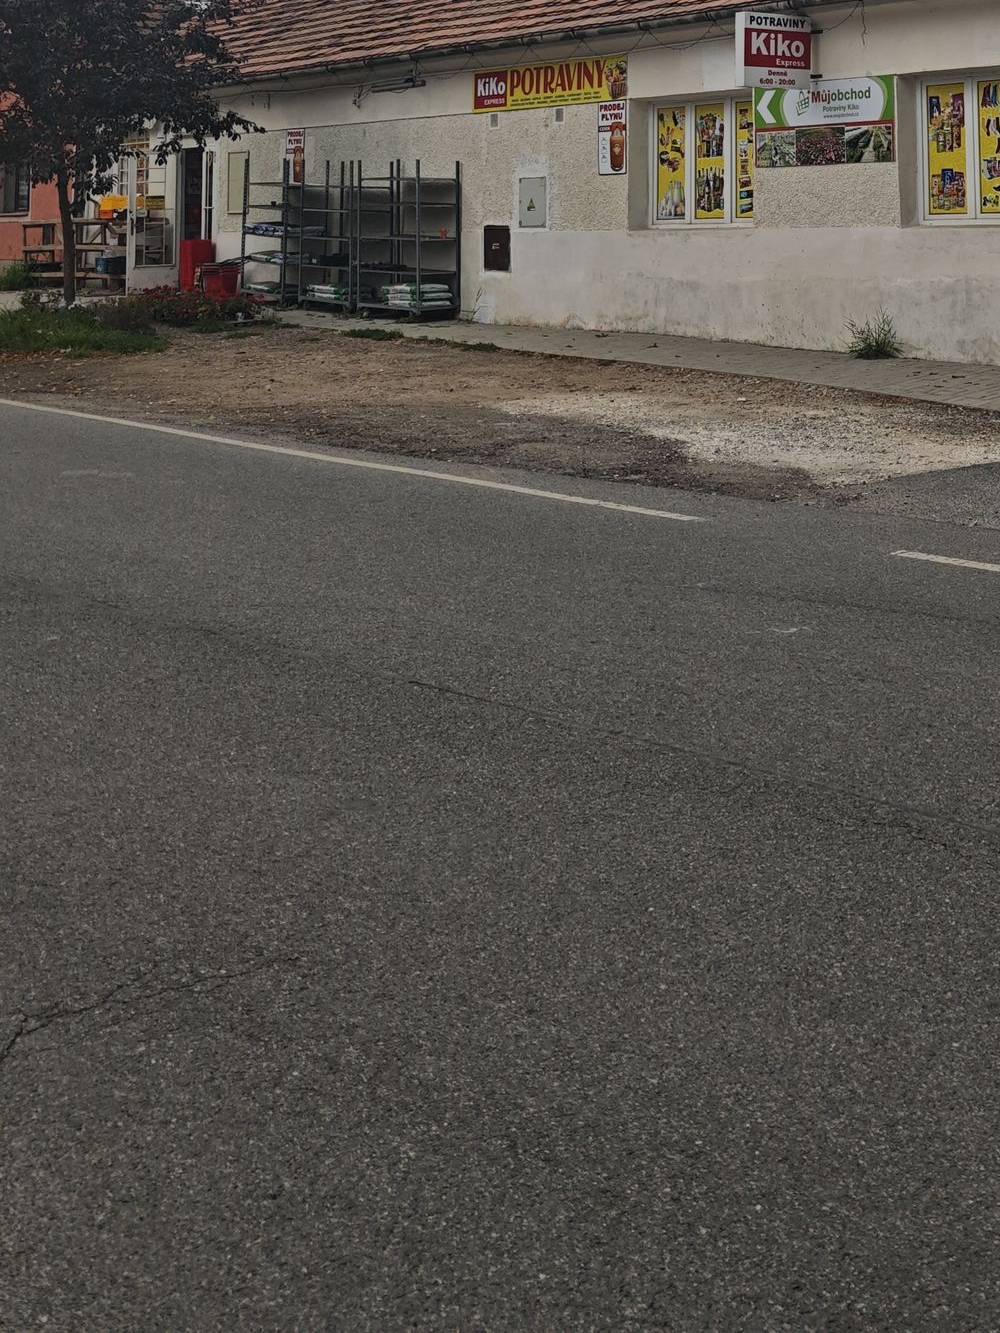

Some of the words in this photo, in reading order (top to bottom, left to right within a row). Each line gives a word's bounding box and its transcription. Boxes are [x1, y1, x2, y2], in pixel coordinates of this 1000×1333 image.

[750, 15, 806, 28] POTRAVINY
[751, 31, 805, 58] Kiko
[776, 58, 805, 67] Express
[510, 59, 606, 96] POTRAVINY
[811, 86, 871, 104] Můjobchod
[484, 98, 505, 106] EXPRESS
[599, 102, 625, 112] PRODEJ
[822, 105, 846, 113] Potraviny
[601, 112, 623, 121] PLYNU
